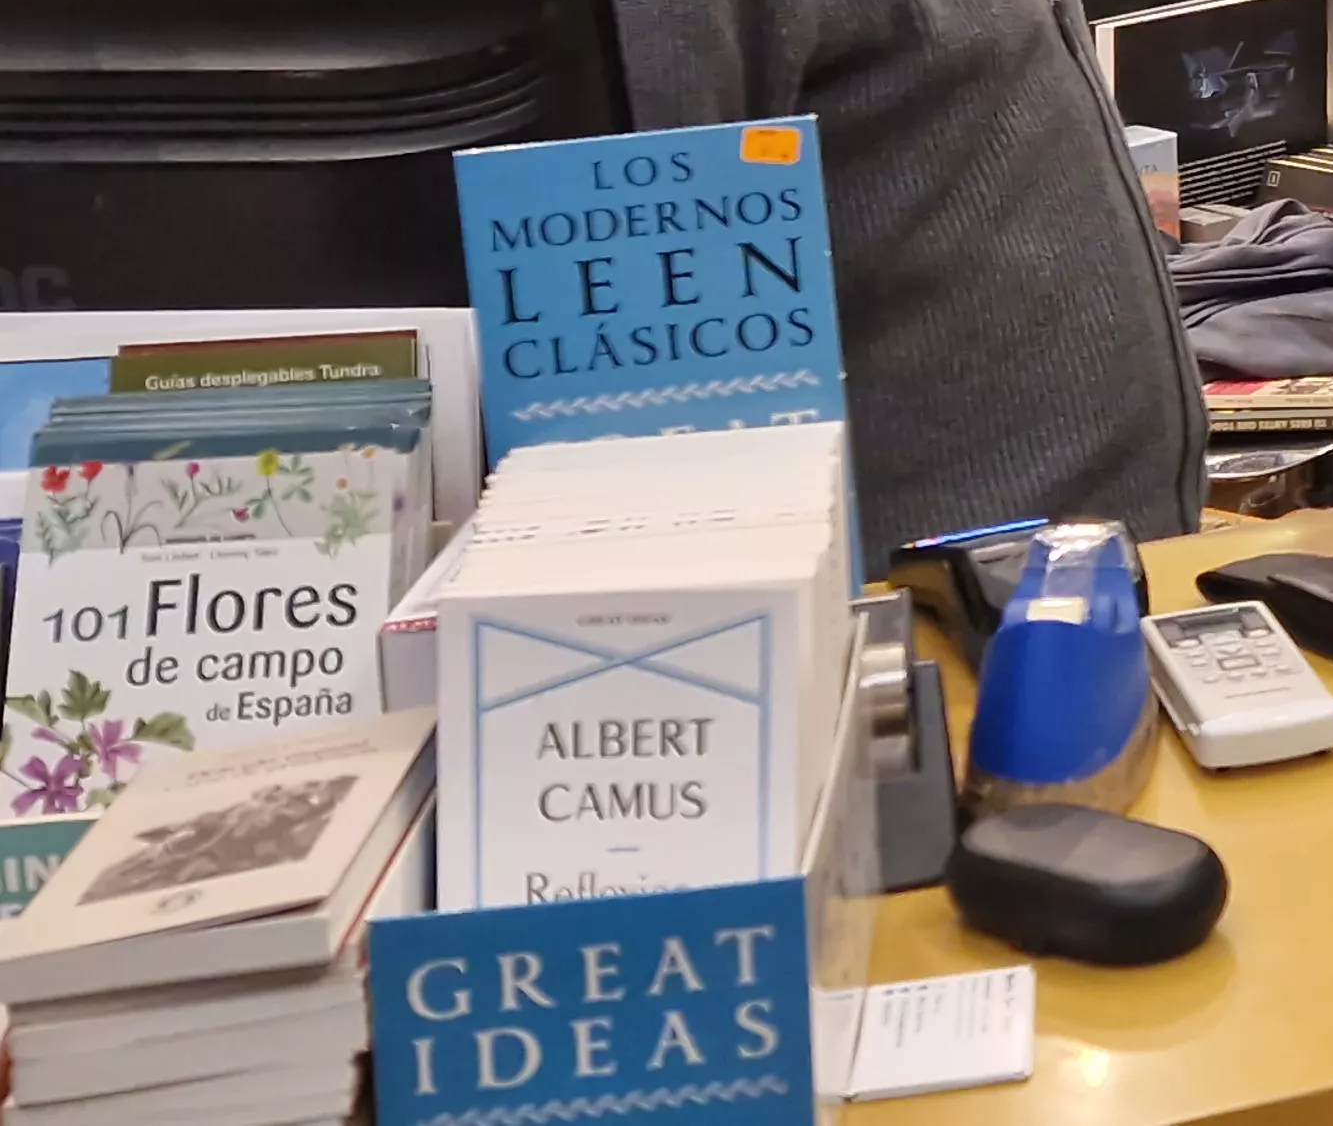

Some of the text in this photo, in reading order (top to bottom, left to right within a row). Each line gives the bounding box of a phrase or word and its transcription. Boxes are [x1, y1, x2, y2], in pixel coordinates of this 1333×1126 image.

[592, 151, 694, 191] LOS
[490, 187, 803, 253] MODERNOS
[497, 236, 803, 325] LEEN
[502, 306, 815, 379] CLÁSICOS
[144, 363, 381, 391] Guías desplegables Tundra
[42, 572, 359, 644] 101 Flores
[125, 645, 344, 689] de campo
[205, 687, 352, 727] de España
[536, 716, 715, 761] ALBERT
[537, 780, 709, 824] CAMUS
[406, 924, 776, 1022] GREAT
[410, 998, 780, 1097] IDEAS
